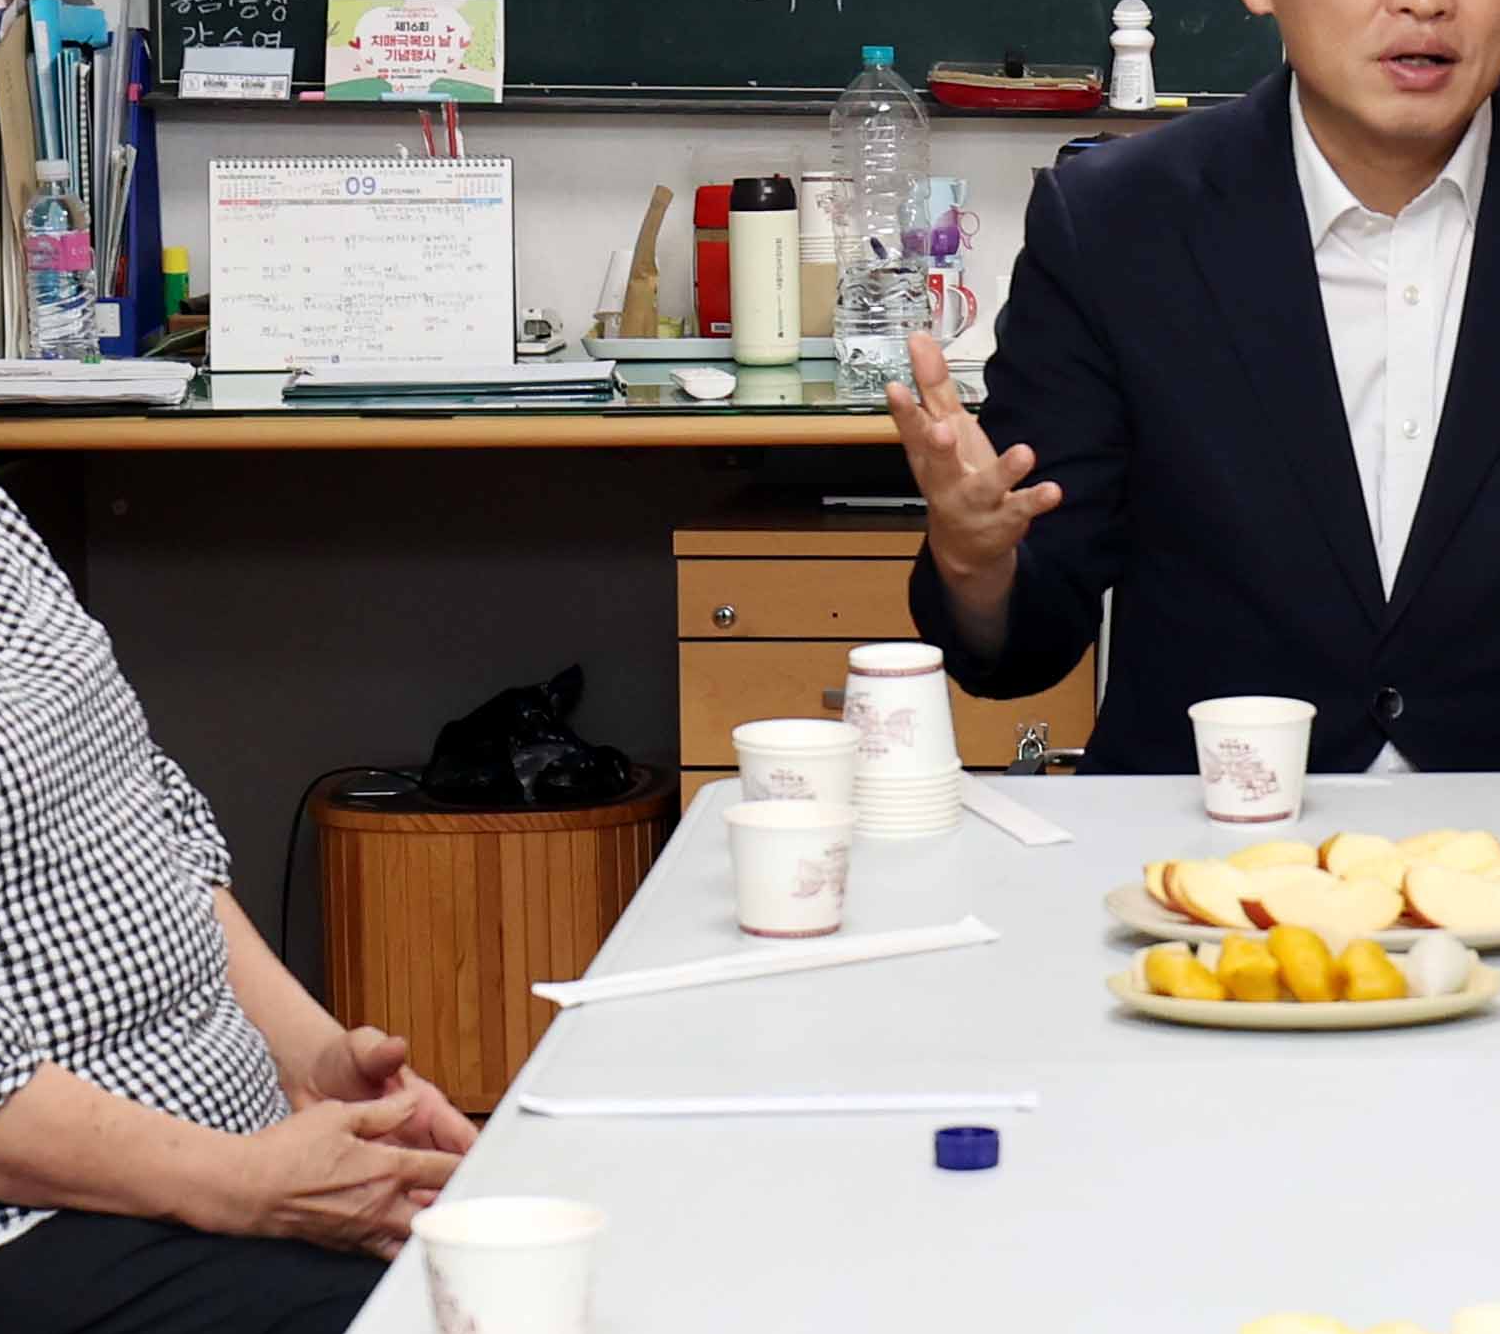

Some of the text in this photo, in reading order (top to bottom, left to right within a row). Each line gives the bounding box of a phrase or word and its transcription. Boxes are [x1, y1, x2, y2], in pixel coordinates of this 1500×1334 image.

[394, 21, 430, 33] 제16회
[371, 34, 452, 49] 치매극복의 날
[384, 49, 437, 62] 기념행사
[345, 176, 377, 196] 09
